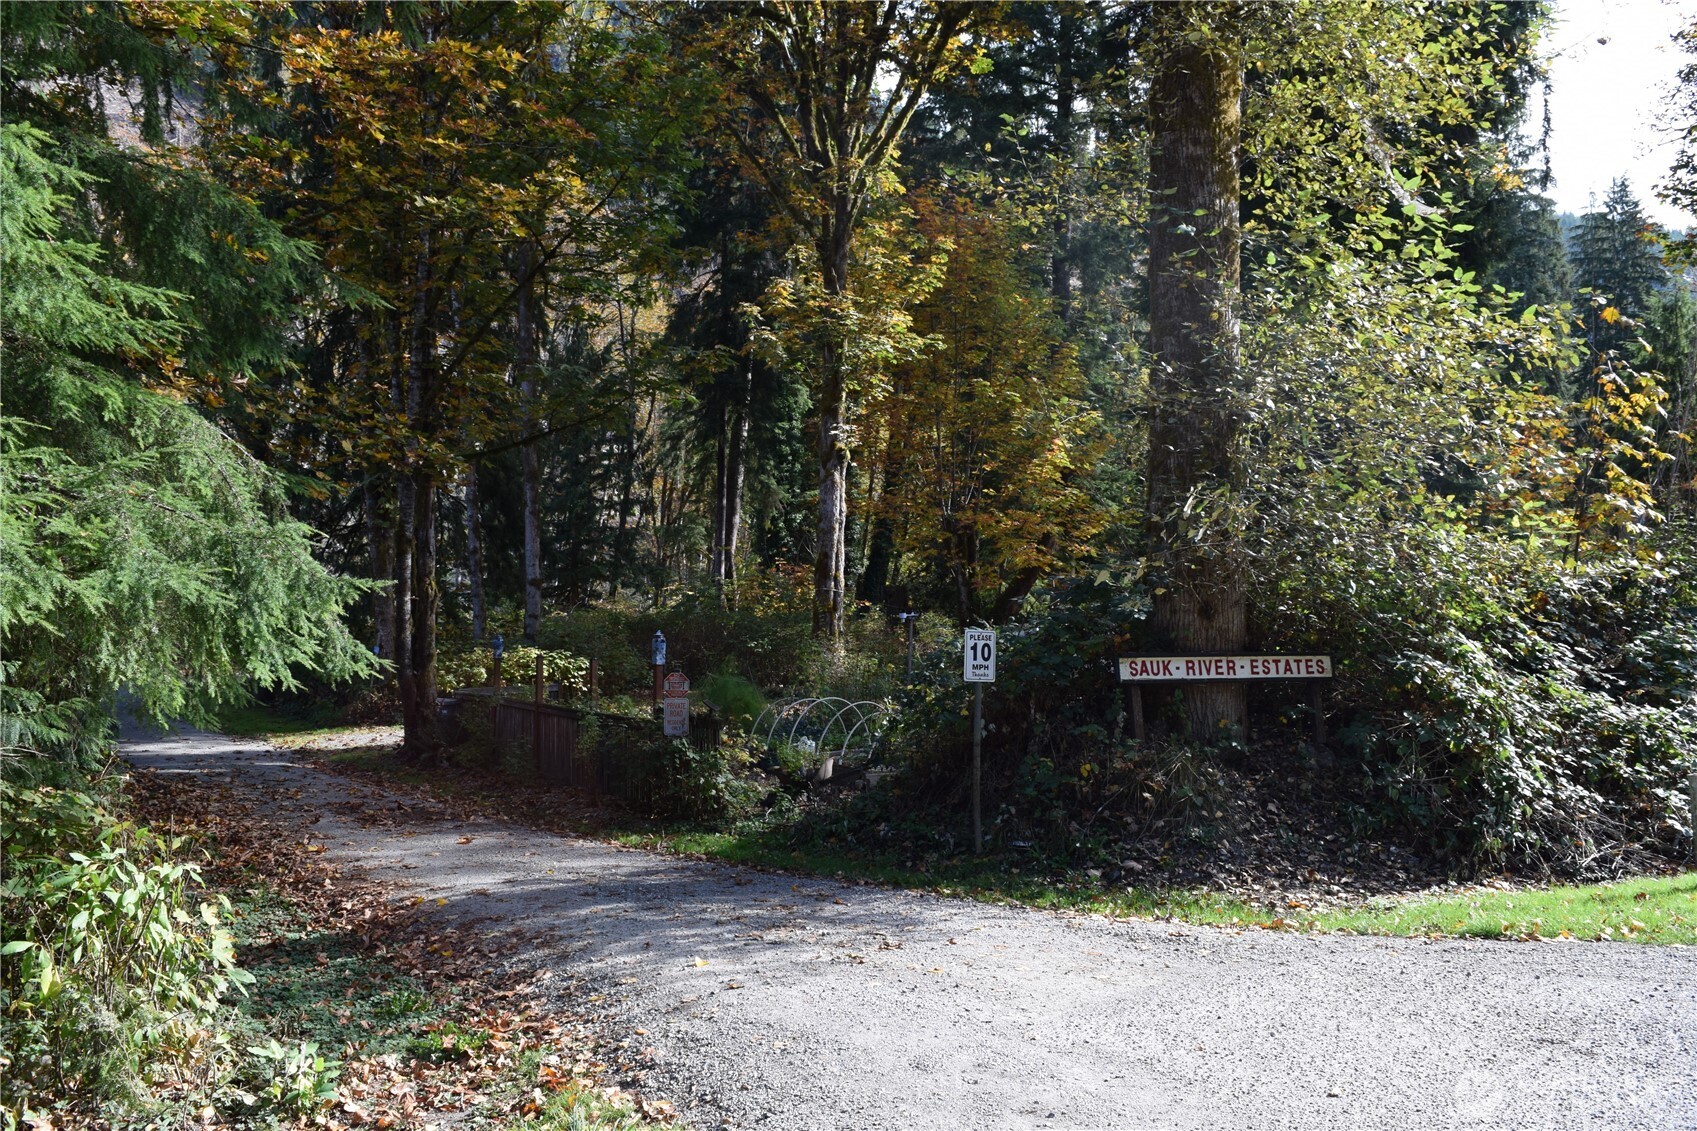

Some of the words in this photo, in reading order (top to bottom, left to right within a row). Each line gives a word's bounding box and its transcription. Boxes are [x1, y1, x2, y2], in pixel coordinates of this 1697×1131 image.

[970, 642, 992, 662] 10
[1128, 659, 1173, 677] SAUK
[1185, 659, 1236, 676] RIVER
[1250, 659, 1325, 675] ESTATES
[667, 702, 686, 710] PRIVATE
